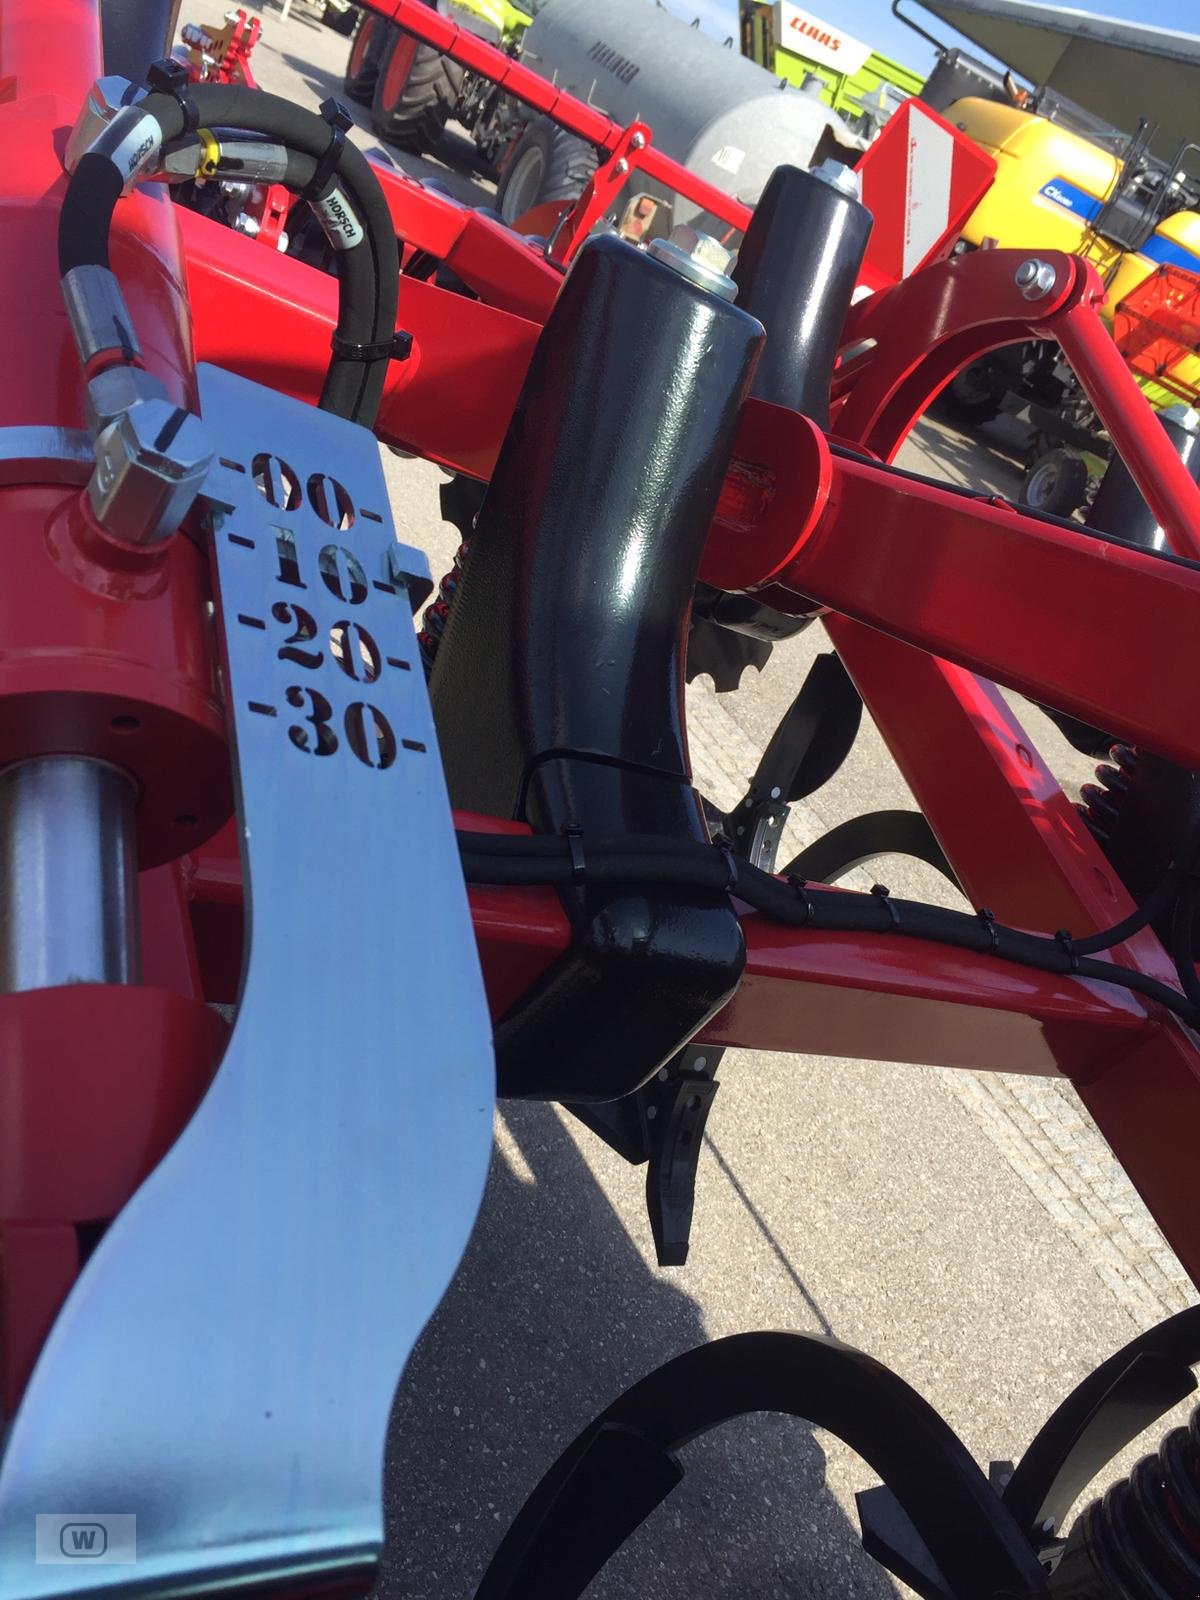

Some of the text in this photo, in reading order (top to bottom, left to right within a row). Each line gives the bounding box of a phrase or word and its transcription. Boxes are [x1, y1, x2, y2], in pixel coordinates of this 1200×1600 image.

[789, 17, 842, 52] CLAAS
[128, 134, 154, 172] HORSCH
[326, 196, 356, 238] HORSCH
